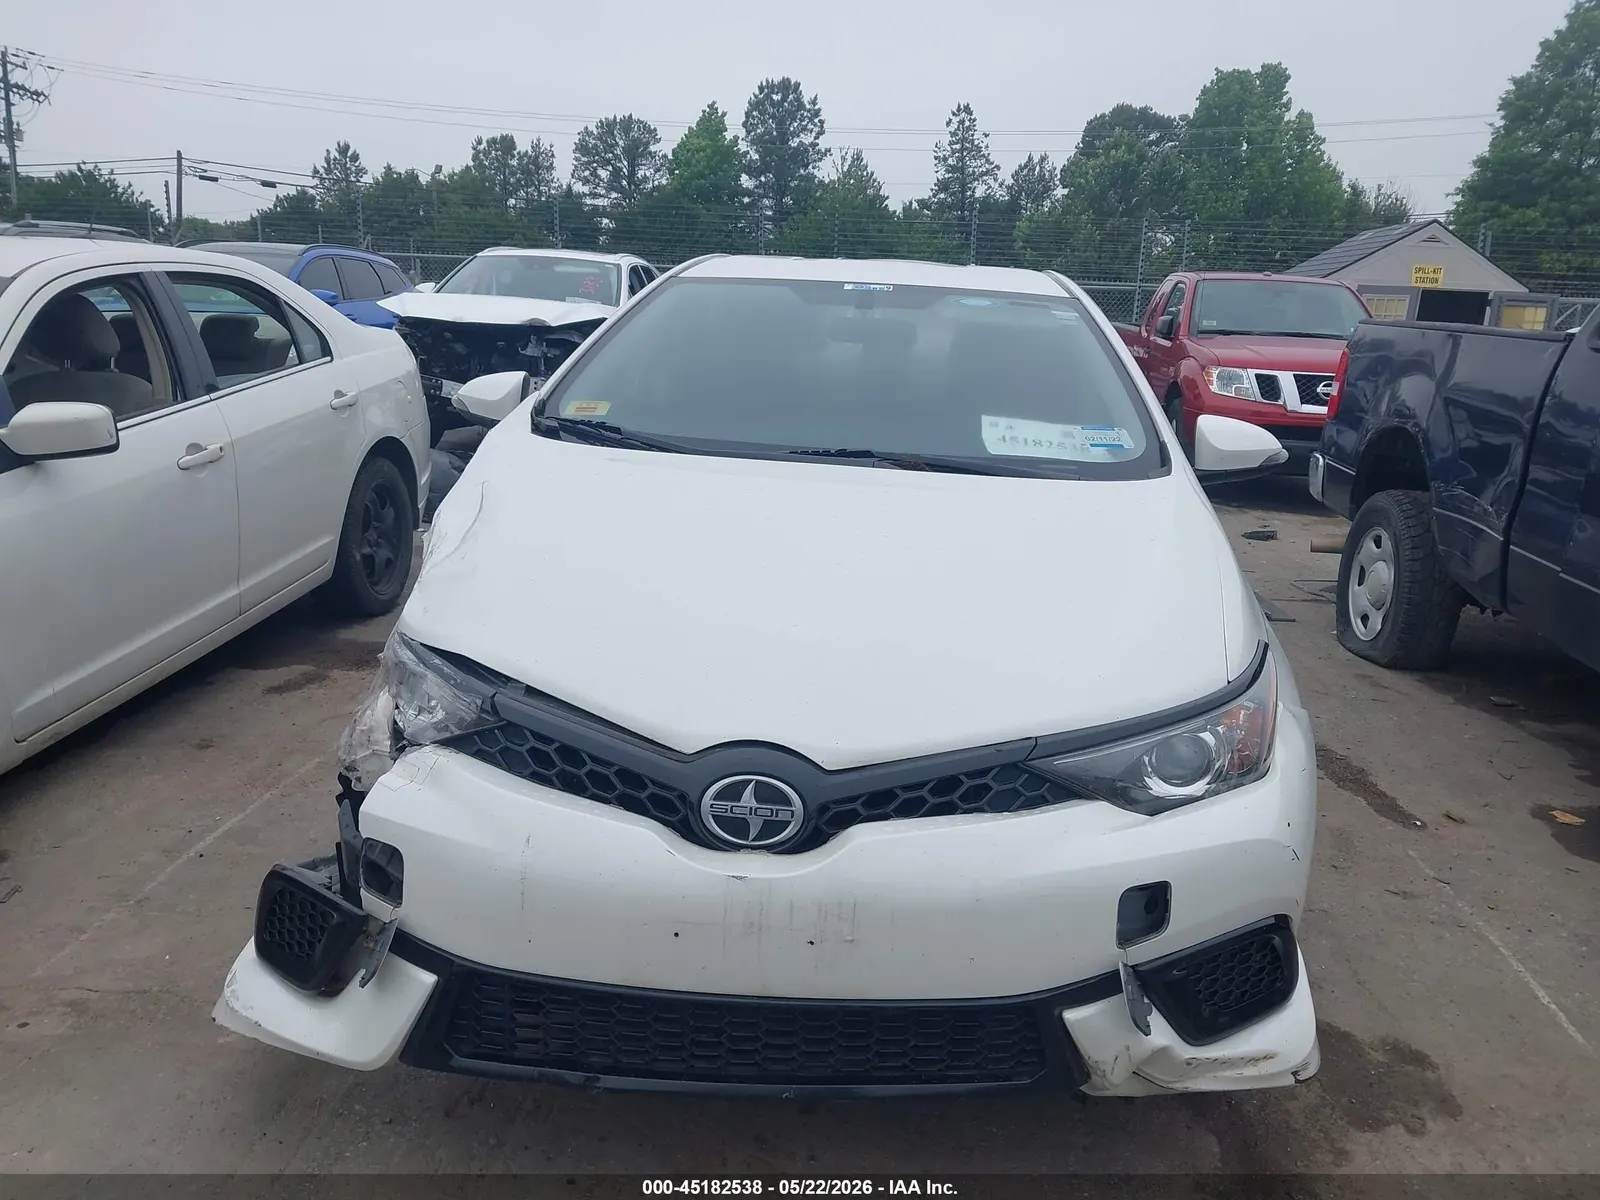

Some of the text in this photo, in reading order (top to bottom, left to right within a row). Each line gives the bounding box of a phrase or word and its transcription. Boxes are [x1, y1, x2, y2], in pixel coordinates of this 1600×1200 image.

[1414, 266, 1442, 275] SPILL-KIT
[1414, 276, 1440, 285] STATION
[709, 803, 795, 819] SCION
